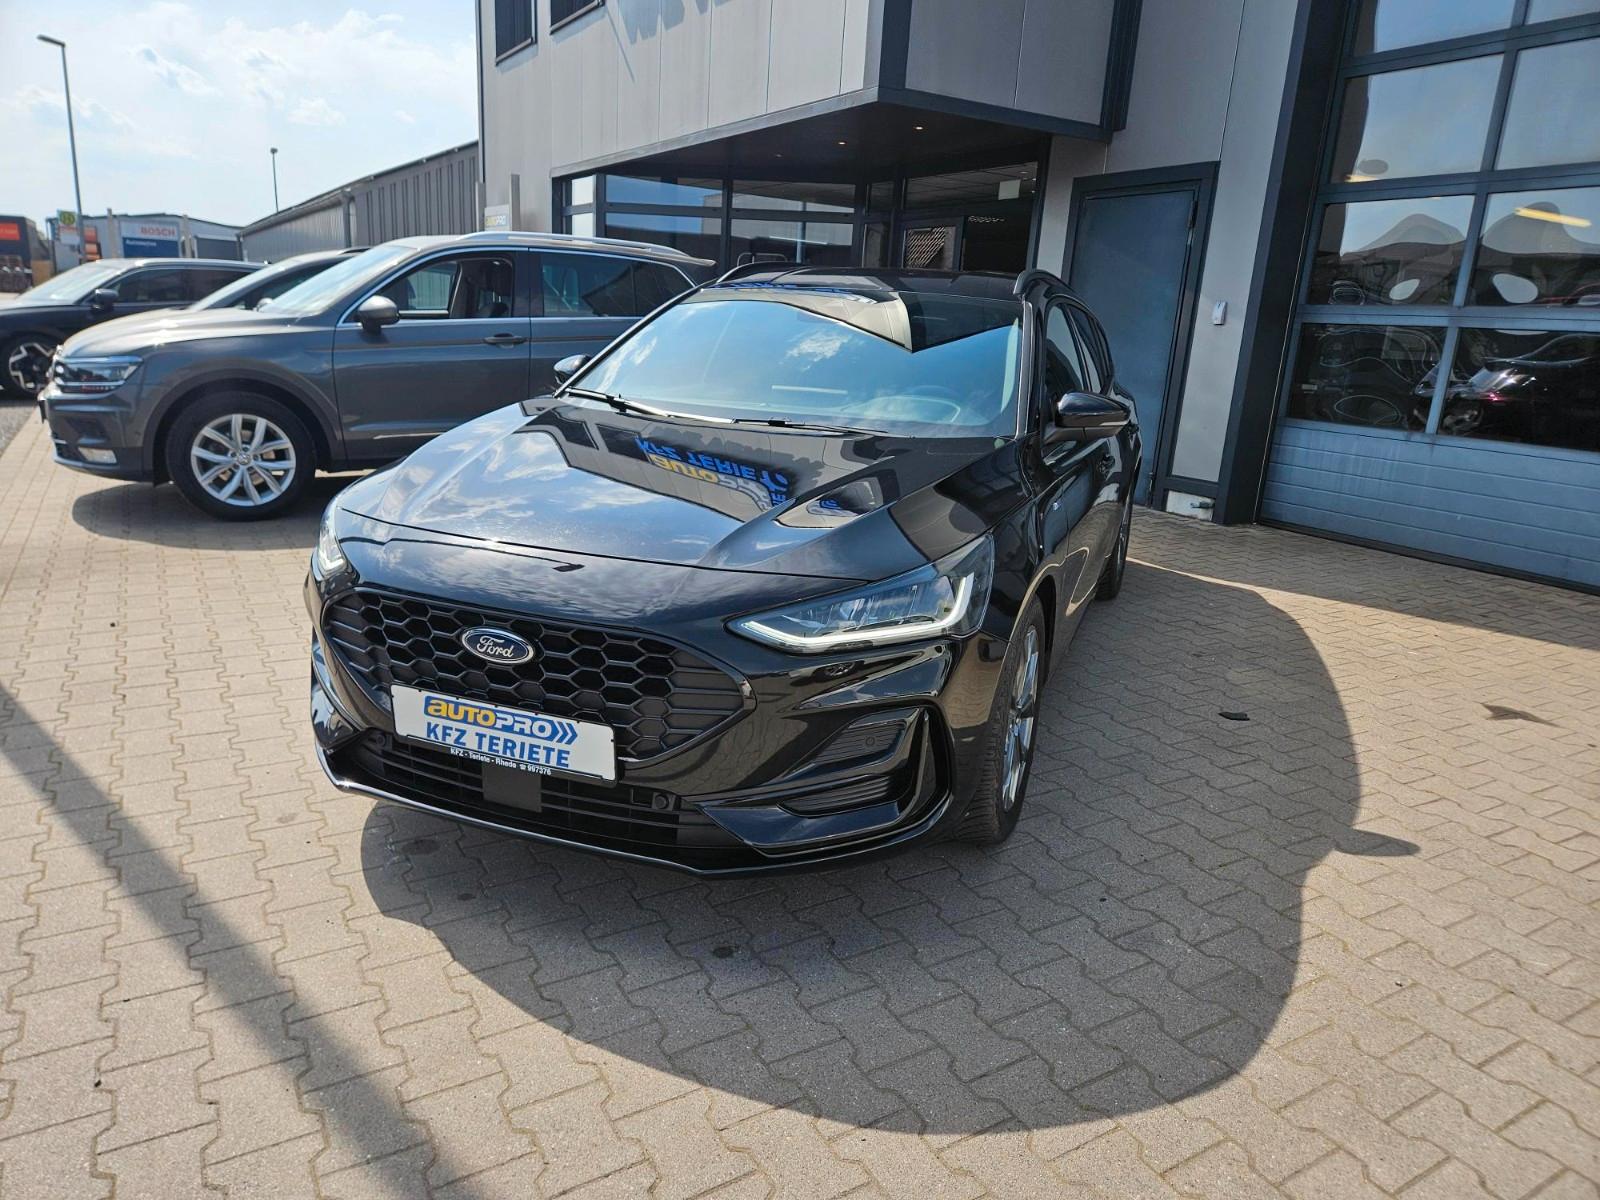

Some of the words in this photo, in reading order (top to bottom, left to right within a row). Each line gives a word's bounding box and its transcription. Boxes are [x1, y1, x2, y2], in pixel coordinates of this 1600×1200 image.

[140, 226, 176, 237] BOSCH
[476, 635, 514, 657] Ford
[426, 721, 467, 747] KFZ
[475, 732, 571, 768] TERIETE
[450, 746, 464, 757] KFZ
[469, 751, 491, 763] Teriete
[496, 757, 517, 769] Rhede
